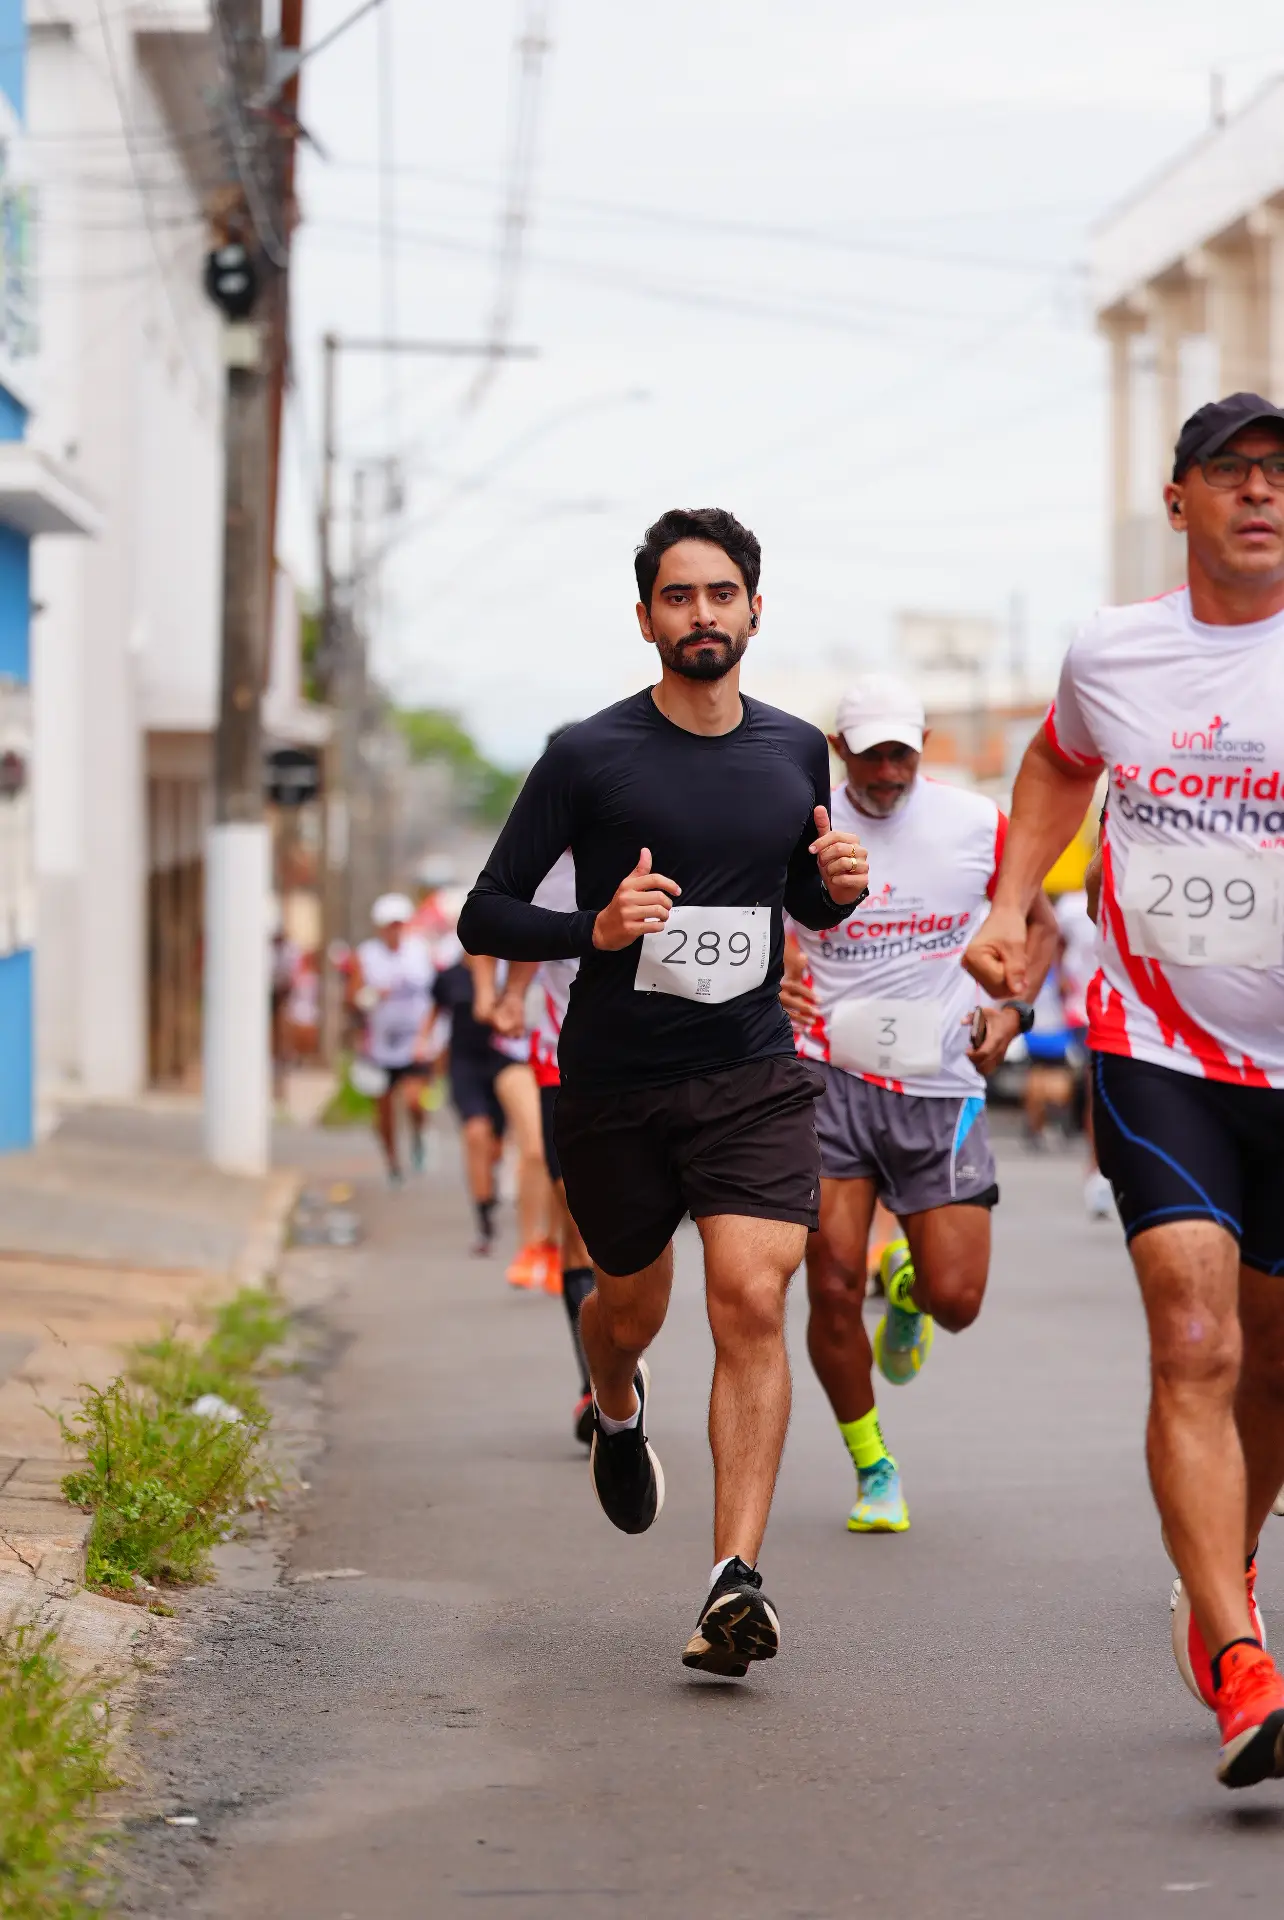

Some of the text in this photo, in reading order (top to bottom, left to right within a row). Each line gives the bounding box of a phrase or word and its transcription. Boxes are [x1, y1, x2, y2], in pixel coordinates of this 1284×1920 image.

[1149, 766, 1284, 801] Corrid
[1147, 873, 1255, 920] 299
[846, 912, 954, 941] Corrida
[661, 930, 751, 967] 289
[877, 1017, 898, 1047] 3
